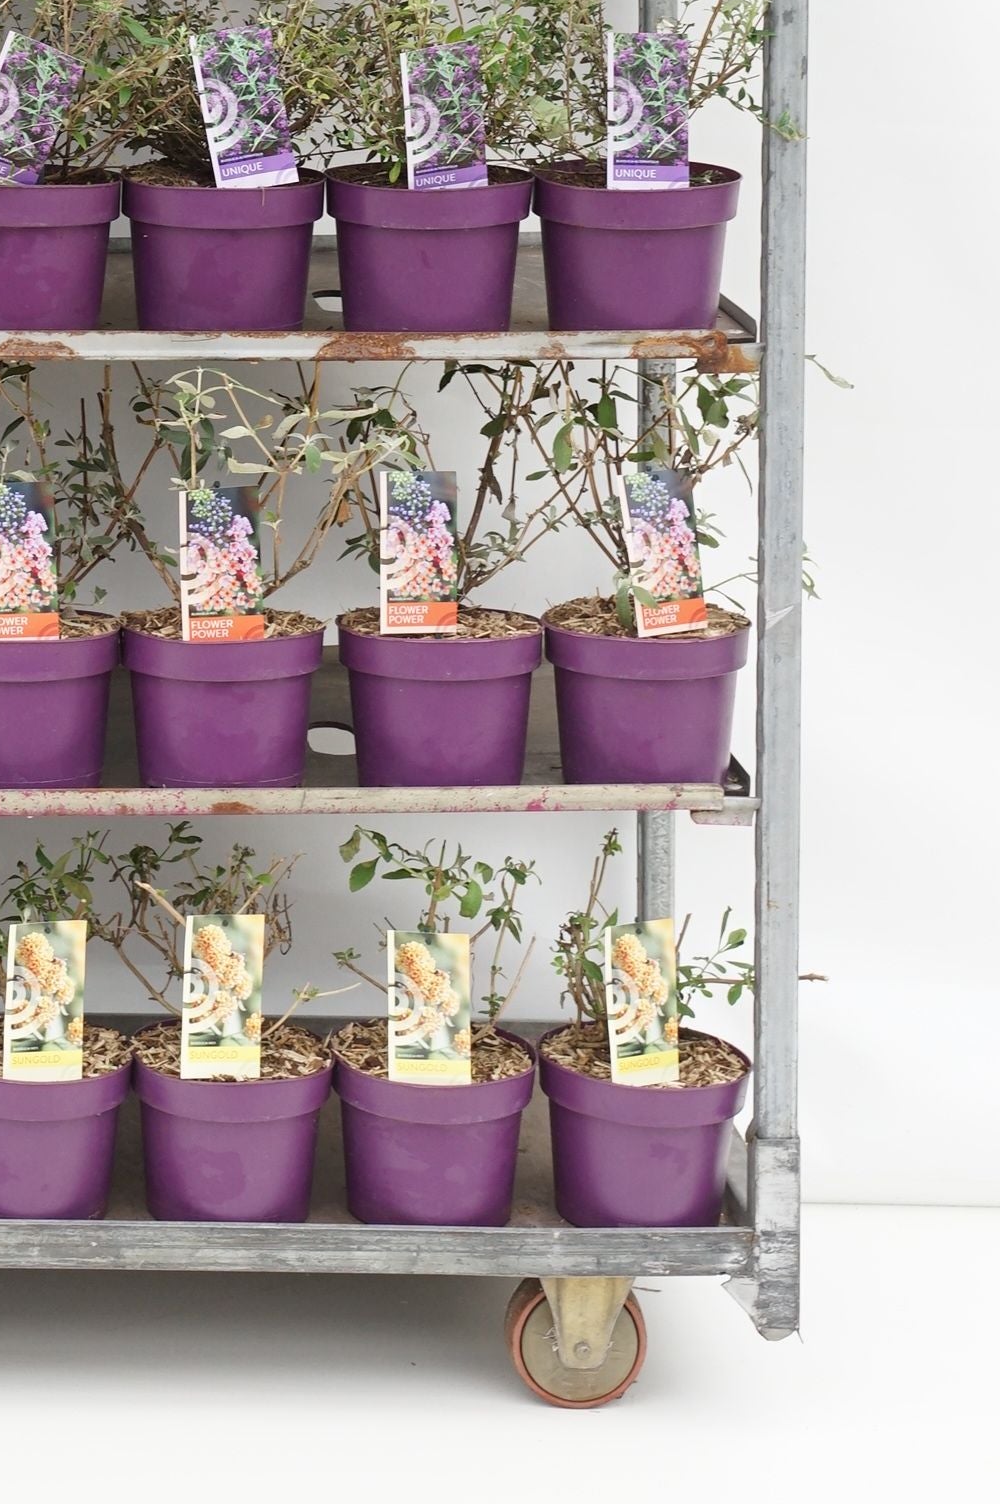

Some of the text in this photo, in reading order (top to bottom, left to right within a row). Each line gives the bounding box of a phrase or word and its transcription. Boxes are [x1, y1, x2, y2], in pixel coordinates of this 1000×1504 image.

[222, 161, 264, 177] UNIQUE
[615, 168, 657, 179] UNIQUE
[415, 173, 456, 187] UNIQUE
[388, 605, 429, 615] FLOWER
[643, 604, 681, 617] FLOWER
[191, 619, 233, 629] FLOWER
[388, 615, 425, 625] POWER
[644, 614, 677, 626] POWER
[191, 629, 230, 639] POWER
[11, 1055, 62, 1066] SUNGOLD
[190, 1050, 239, 1060] SUNGOLD
[397, 1062, 448, 1073] SUNGOLD
[619, 1056, 661, 1072] SUNGOLD
